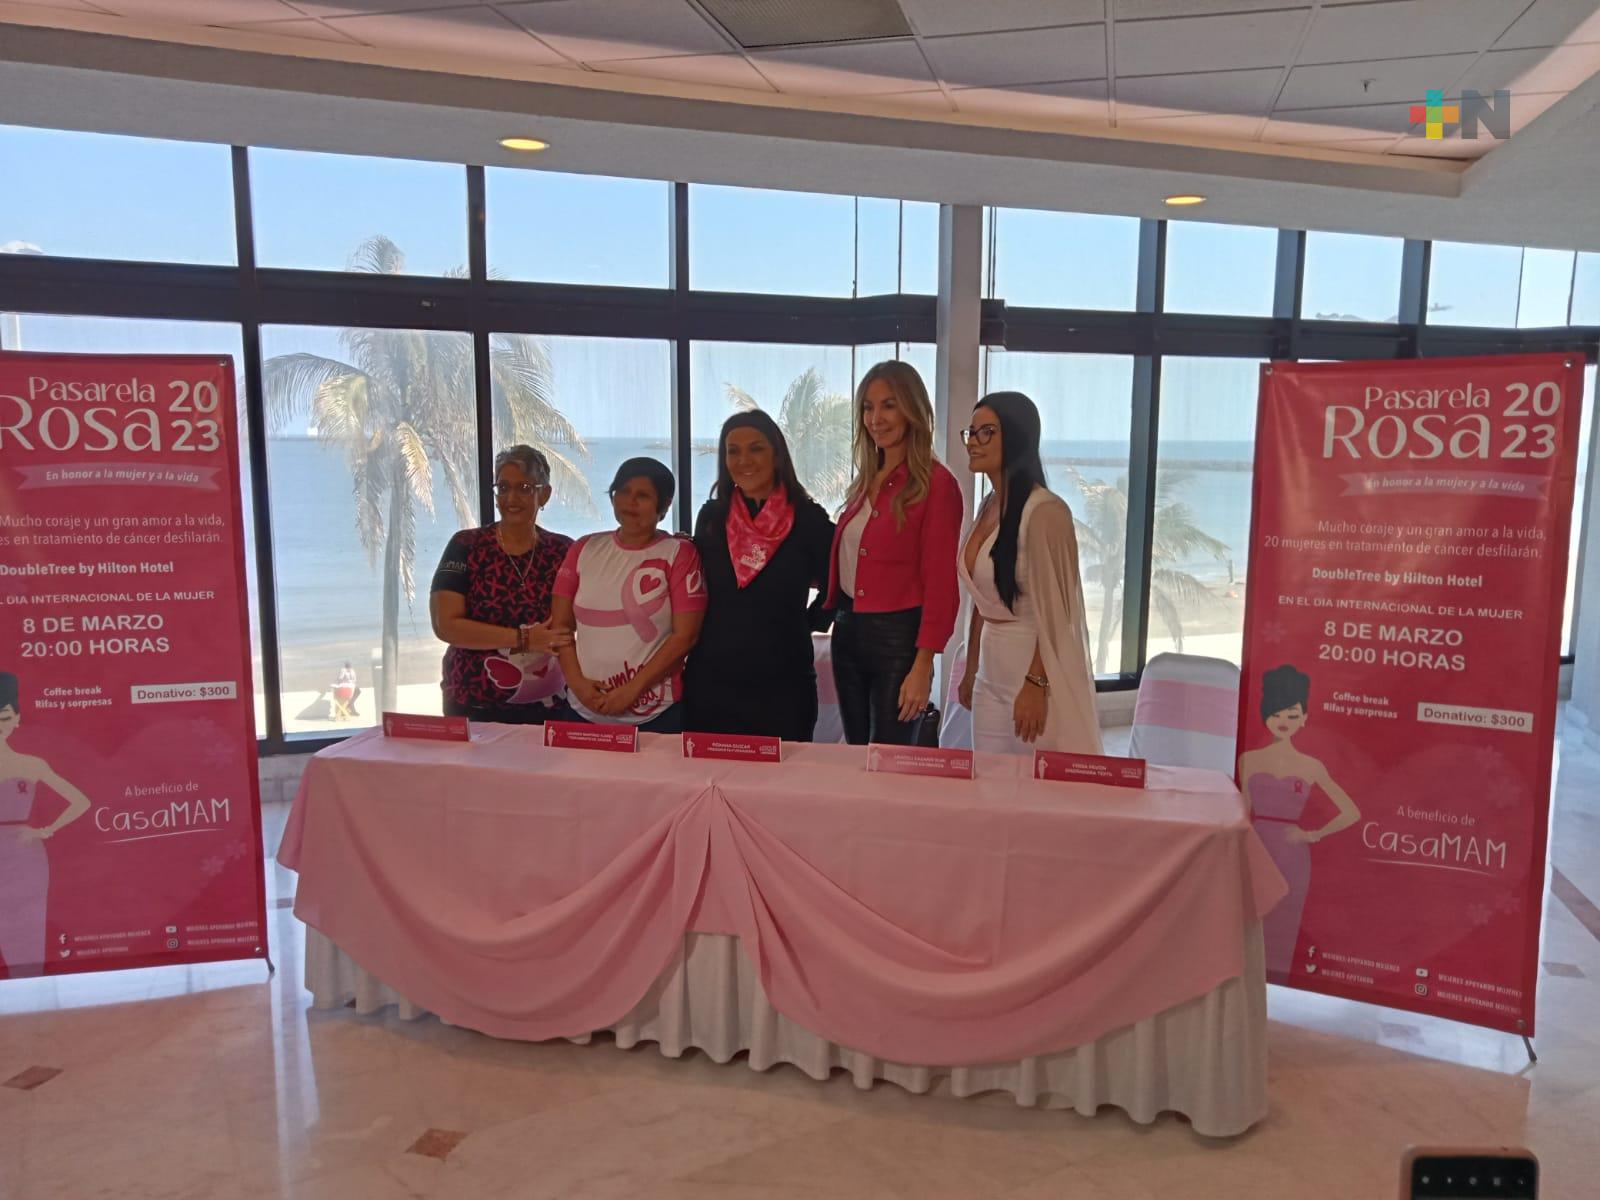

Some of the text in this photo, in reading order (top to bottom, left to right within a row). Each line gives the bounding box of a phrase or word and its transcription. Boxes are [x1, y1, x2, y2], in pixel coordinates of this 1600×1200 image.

[28, 376, 155, 402] Pasarela
[168, 380, 218, 413] 20
[1364, 382, 1490, 409] Pasarela
[1503, 381, 1561, 416] 20
[171, 419, 220, 451] 23
[1322, 405, 1490, 458] Rosa
[1500, 424, 1555, 458] 23
[46, 471, 59, 481] En
[62, 469, 92, 480] honor
[104, 469, 113, 479] la
[115, 470, 145, 482] mujer
[148, 472, 155, 481] y
[156, 472, 162, 480] a
[165, 470, 174, 480] la
[177, 471, 199, 483] vida
[1382, 476, 1412, 487] honor
[1415, 479, 1422, 487] a
[1424, 476, 1433, 487] la
[1437, 478, 1467, 490] mujer
[1469, 480, 1477, 490] y
[1479, 480, 1486, 489] a
[1489, 477, 1498, 489] la
[1502, 480, 1525, 492] vida
[0, 513, 225, 530] Mucho coraje y un gran amor a la vida,
[1318, 520, 1357, 533] Mucho
[1360, 522, 1394, 537] coraje
[1396, 526, 1403, 538] y
[1407, 526, 1422, 536] un
[1425, 526, 1452, 539] gran
[1456, 527, 1489, 538] amor
[1492, 528, 1499, 538] a
[1503, 525, 1513, 538] la
[14, 534, 29, 545] en
[33, 532, 102, 545] tratamiento
[106, 531, 120, 544] de
[124, 531, 160, 544] cáncer
[1264, 535, 1279, 548] 20
[1282, 538, 1325, 552] mujeres
[1328, 540, 1342, 550] en
[1346, 540, 1413, 553] tratamiento
[1416, 541, 1431, 554] de
[0, 561, 174, 577] DoubleTree by Hilton Hotel
[1312, 567, 1483, 587] DoubleTree by Hilton Hotel
[31, 591, 133, 604] INTERNACIONAL
[136, 592, 153, 602] DE
[155, 592, 170, 602] LA
[174, 590, 215, 600] MUJER
[1278, 595, 1523, 620] EN EL DIA INTERNACIONAL DE LA MUJER
[23, 614, 164, 633] 8 DE MARZO
[1324, 621, 1463, 647] 8 DE MARZO
[21, 637, 170, 658] 20:00 HORAS
[1319, 644, 1466, 672] 20:00 HORAS
[43, 685, 102, 697] Coffee break
[137, 685, 230, 701] Donativo: $300
[1333, 691, 1389, 706] Coffee break
[35, 697, 112, 710] Rifas y sorpresas
[1354, 706, 1398, 719] sorpresas
[1424, 707, 1525, 728] Donativo: $300
[125, 780, 199, 797] A beneficio de
[95, 798, 231, 832] CasaMAM
[1397, 806, 1475, 826] A beneficio de
[1362, 822, 1506, 868] CasaMAM
